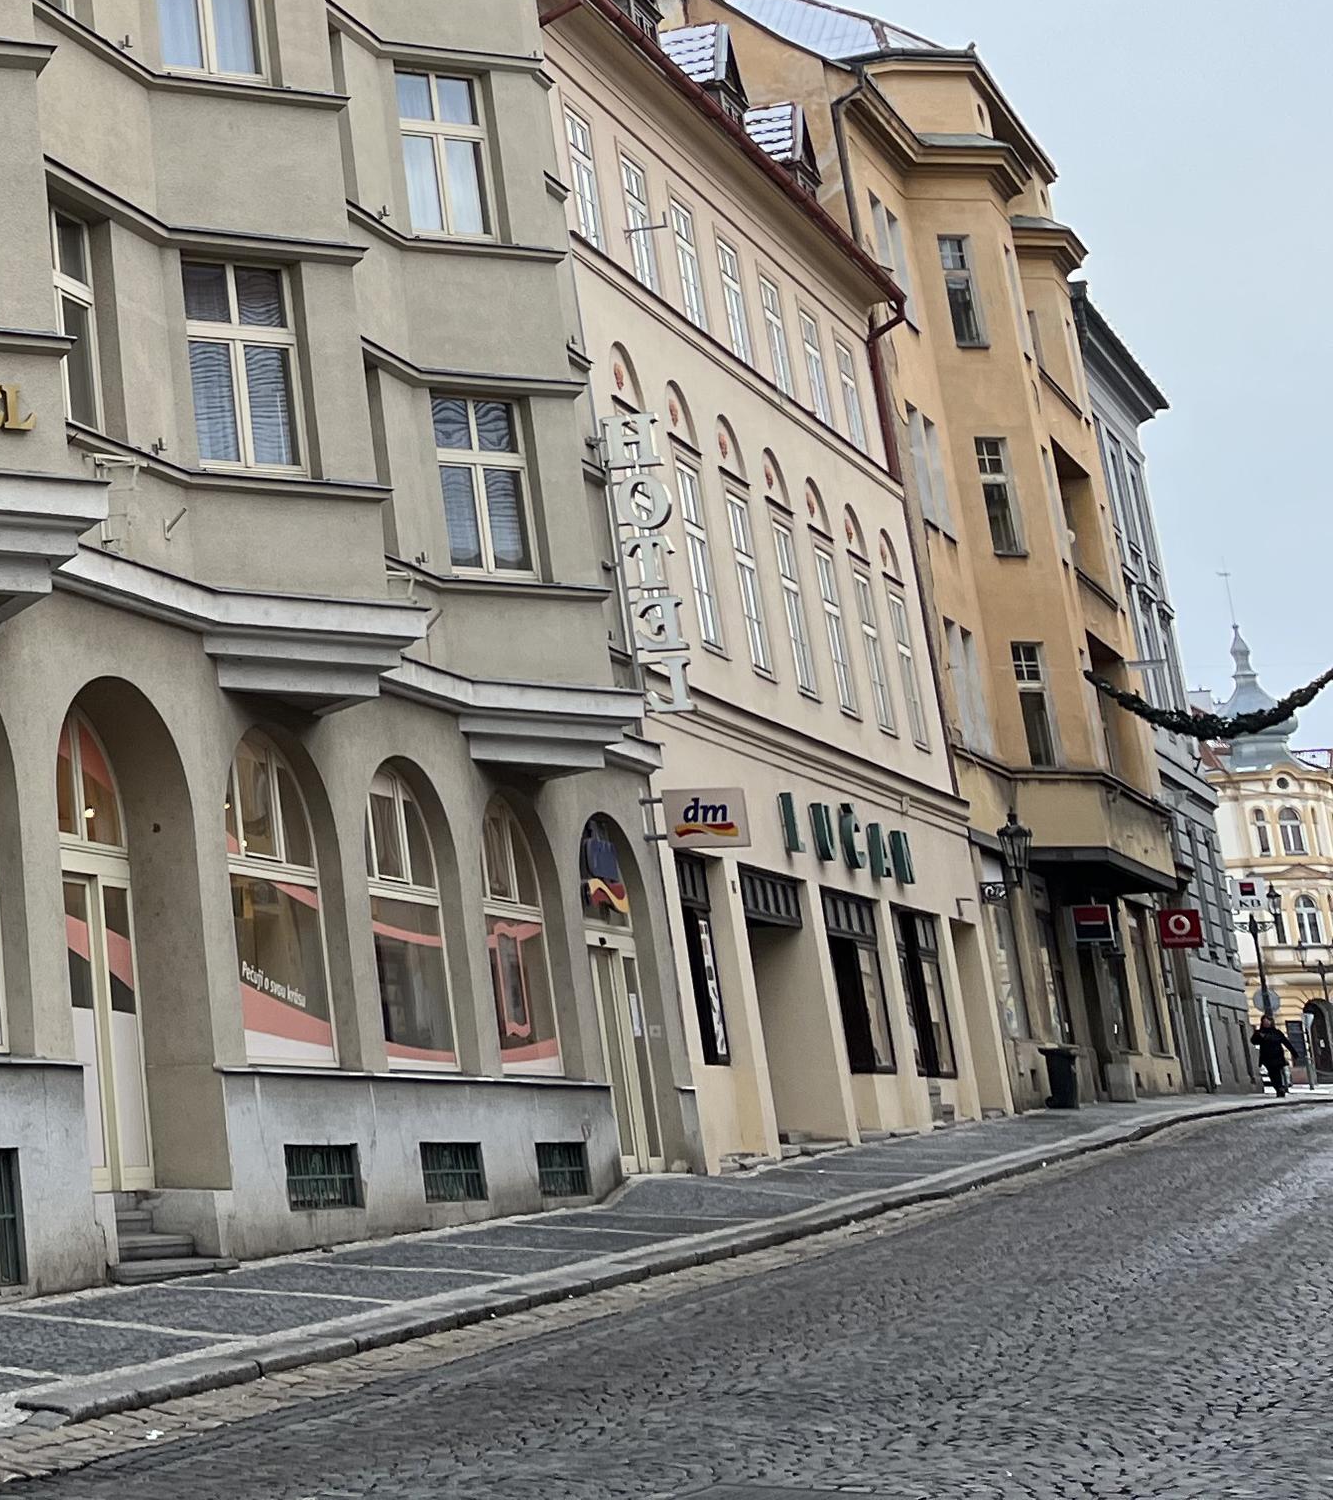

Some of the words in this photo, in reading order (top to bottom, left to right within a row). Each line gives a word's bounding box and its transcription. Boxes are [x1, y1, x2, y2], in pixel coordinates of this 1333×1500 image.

[683, 798, 728, 824] dm
[777, 792, 916, 884] LUČAN
[1238, 899, 1262, 909] KB
